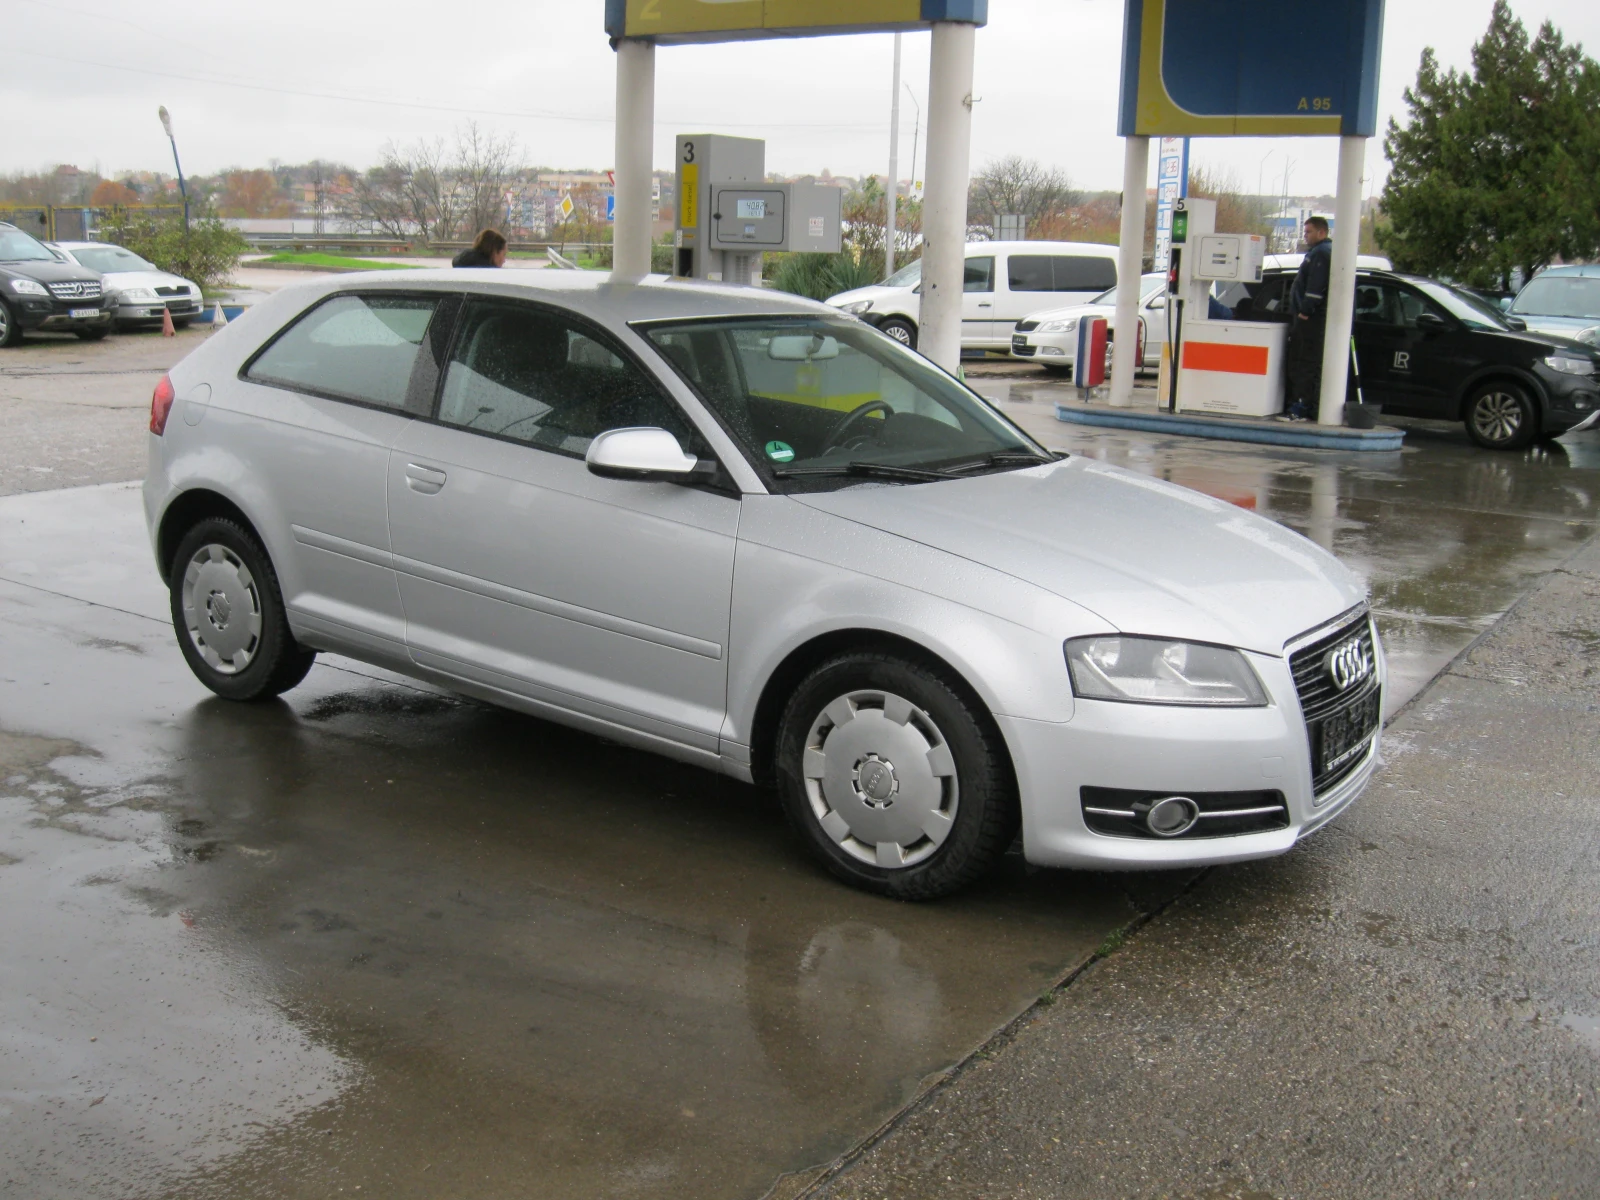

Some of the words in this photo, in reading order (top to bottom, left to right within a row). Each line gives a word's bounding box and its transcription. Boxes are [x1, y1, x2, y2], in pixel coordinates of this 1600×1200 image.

[1297, 97, 1308, 110] A
[1313, 97, 1331, 110] 95
[683, 141, 694, 163] 3
[1177, 198, 1185, 211] 5
